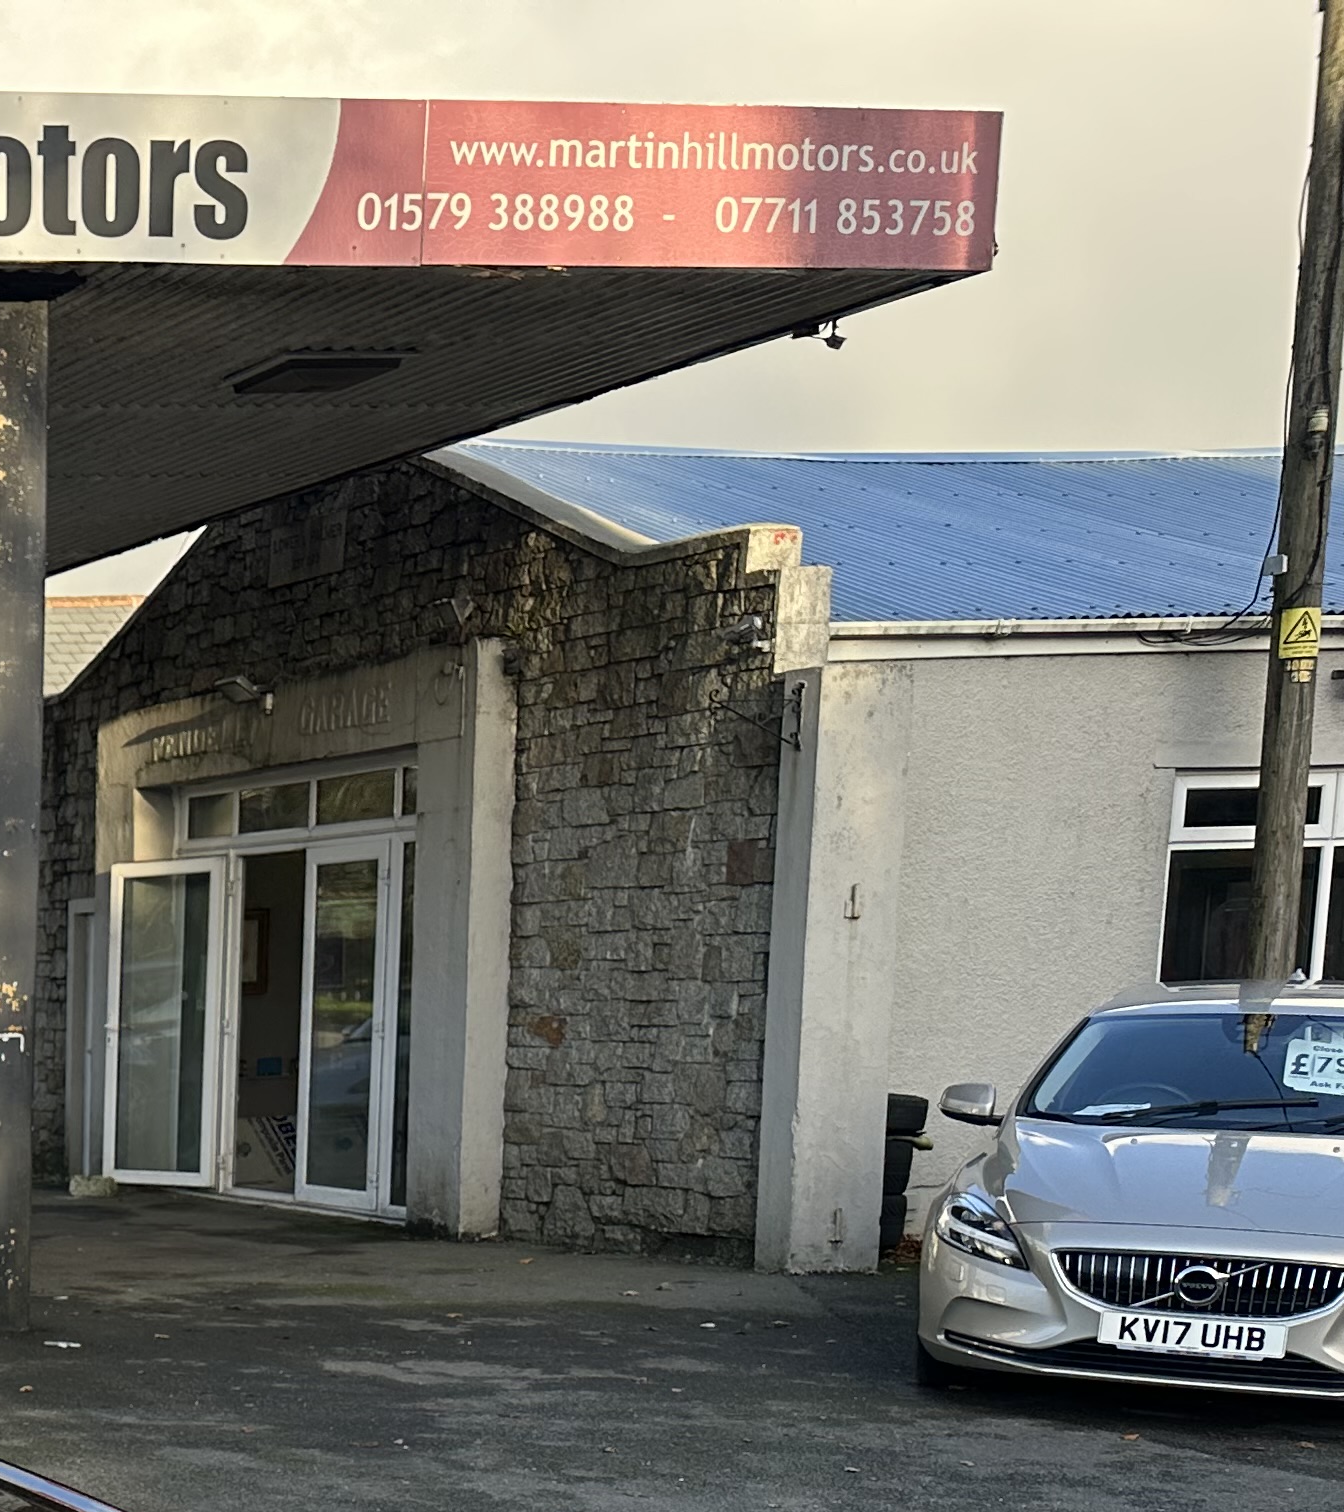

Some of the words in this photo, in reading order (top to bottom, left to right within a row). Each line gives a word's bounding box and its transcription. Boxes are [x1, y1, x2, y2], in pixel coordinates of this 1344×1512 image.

[449, 131, 979, 175] www.martinhillmotors.co.uk
[356, 191, 473, 232] 01579
[487, 192, 635, 232] 388988
[715, 195, 817, 235] 07711
[836, 197, 976, 236] 853758
[300, 683, 392, 735] GARAGE
[1309, 1080, 1332, 1089] Ask
[1118, 1315, 1192, 1345] KV17
[1201, 1323, 1266, 1352] UHB
